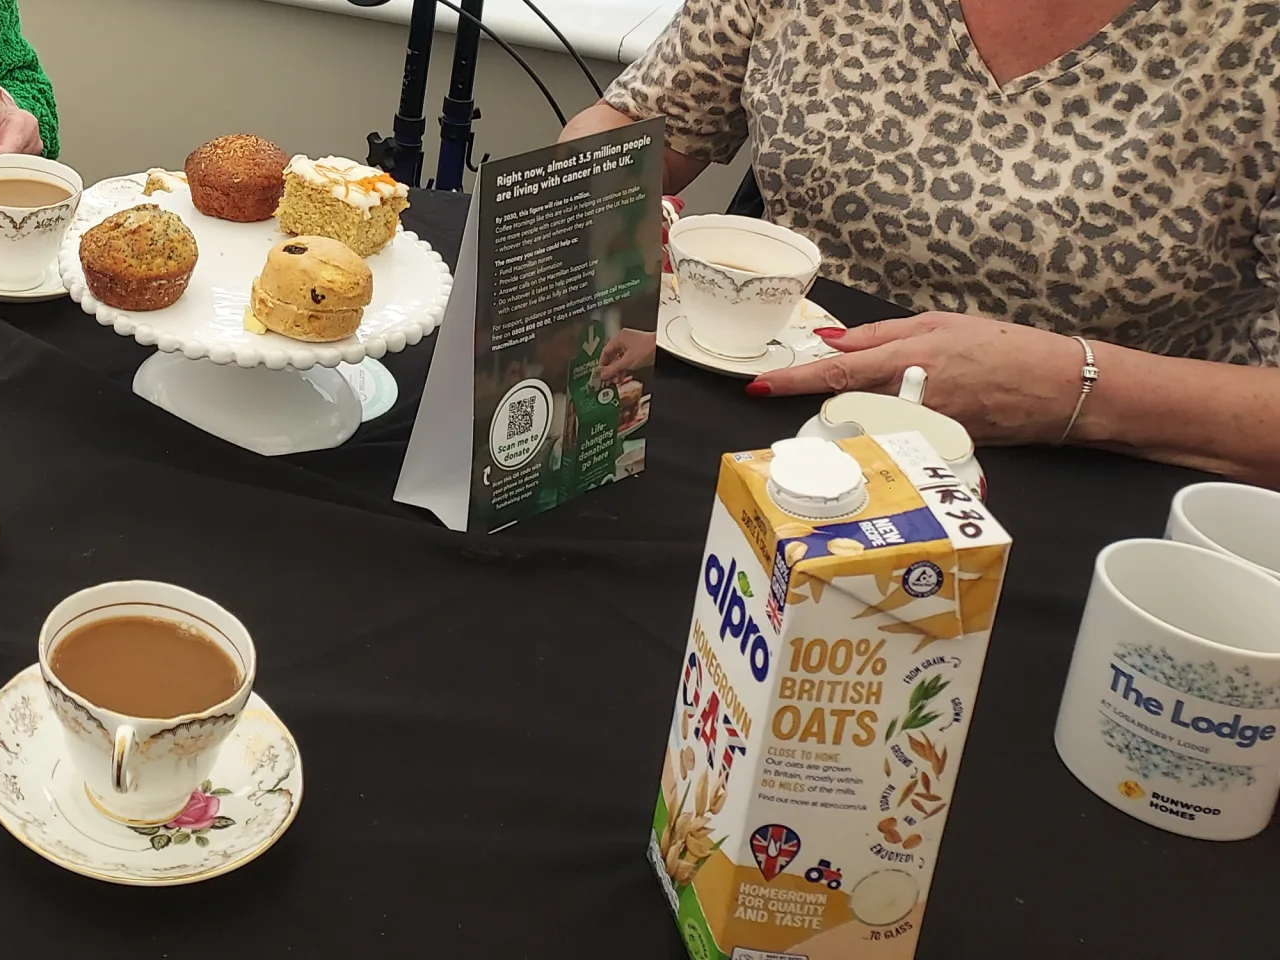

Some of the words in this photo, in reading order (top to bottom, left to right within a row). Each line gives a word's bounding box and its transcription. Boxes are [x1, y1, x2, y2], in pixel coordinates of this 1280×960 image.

[497, 171, 522, 186] Right
[524, 167, 545, 179] now,
[547, 156, 577, 172] almost
[578, 151, 592, 164] 3.5
[594, 144, 621, 160] million
[623, 135, 651, 153] people
[496, 191, 512, 202] are
[514, 183, 538, 197] living
[540, 175, 560, 189] with
[562, 168, 592, 183] cancer
[593, 164, 600, 174] in
[603, 160, 616, 171] the
[619, 154, 634, 166] UK.
[498, 442, 516, 454] Scan
[518, 438, 529, 447] me
[530, 434, 538, 442] to
[504, 447, 530, 462] donate
[880, 470, 895, 484] OAT
[872, 518, 905, 543] NEW
[705, 553, 770, 683] alpro
[789, 638, 887, 676] 100%
[693, 618, 752, 740] HOMEGROWN
[903, 666, 922, 684] FROM
[779, 677, 882, 704] BRITISH
[1110, 663, 1164, 716] The
[1170, 700, 1276, 748] Lodge
[772, 705, 878, 747] OATS
[1102, 699, 1112, 708] AT
[1114, 708, 1174, 742] LOGANBERRY
[1178, 740, 1211, 754] LODGE
[766, 758, 782, 766] Our
[785, 761, 804, 769] oats
[768, 746, 796, 758] CLOSE
[801, 750, 812, 760] TO
[815, 752, 840, 762] HOME
[1150, 801, 1196, 820] HOMES
[1152, 792, 1221, 816] RUNWOOD
[740, 883, 828, 904] HOMEGROWN
[738, 895, 764, 908] FOR
[768, 900, 825, 916] QUALITY
[734, 907, 768, 923] AND
[775, 913, 822, 930] TASTE
[884, 922, 913, 939] GLASS
